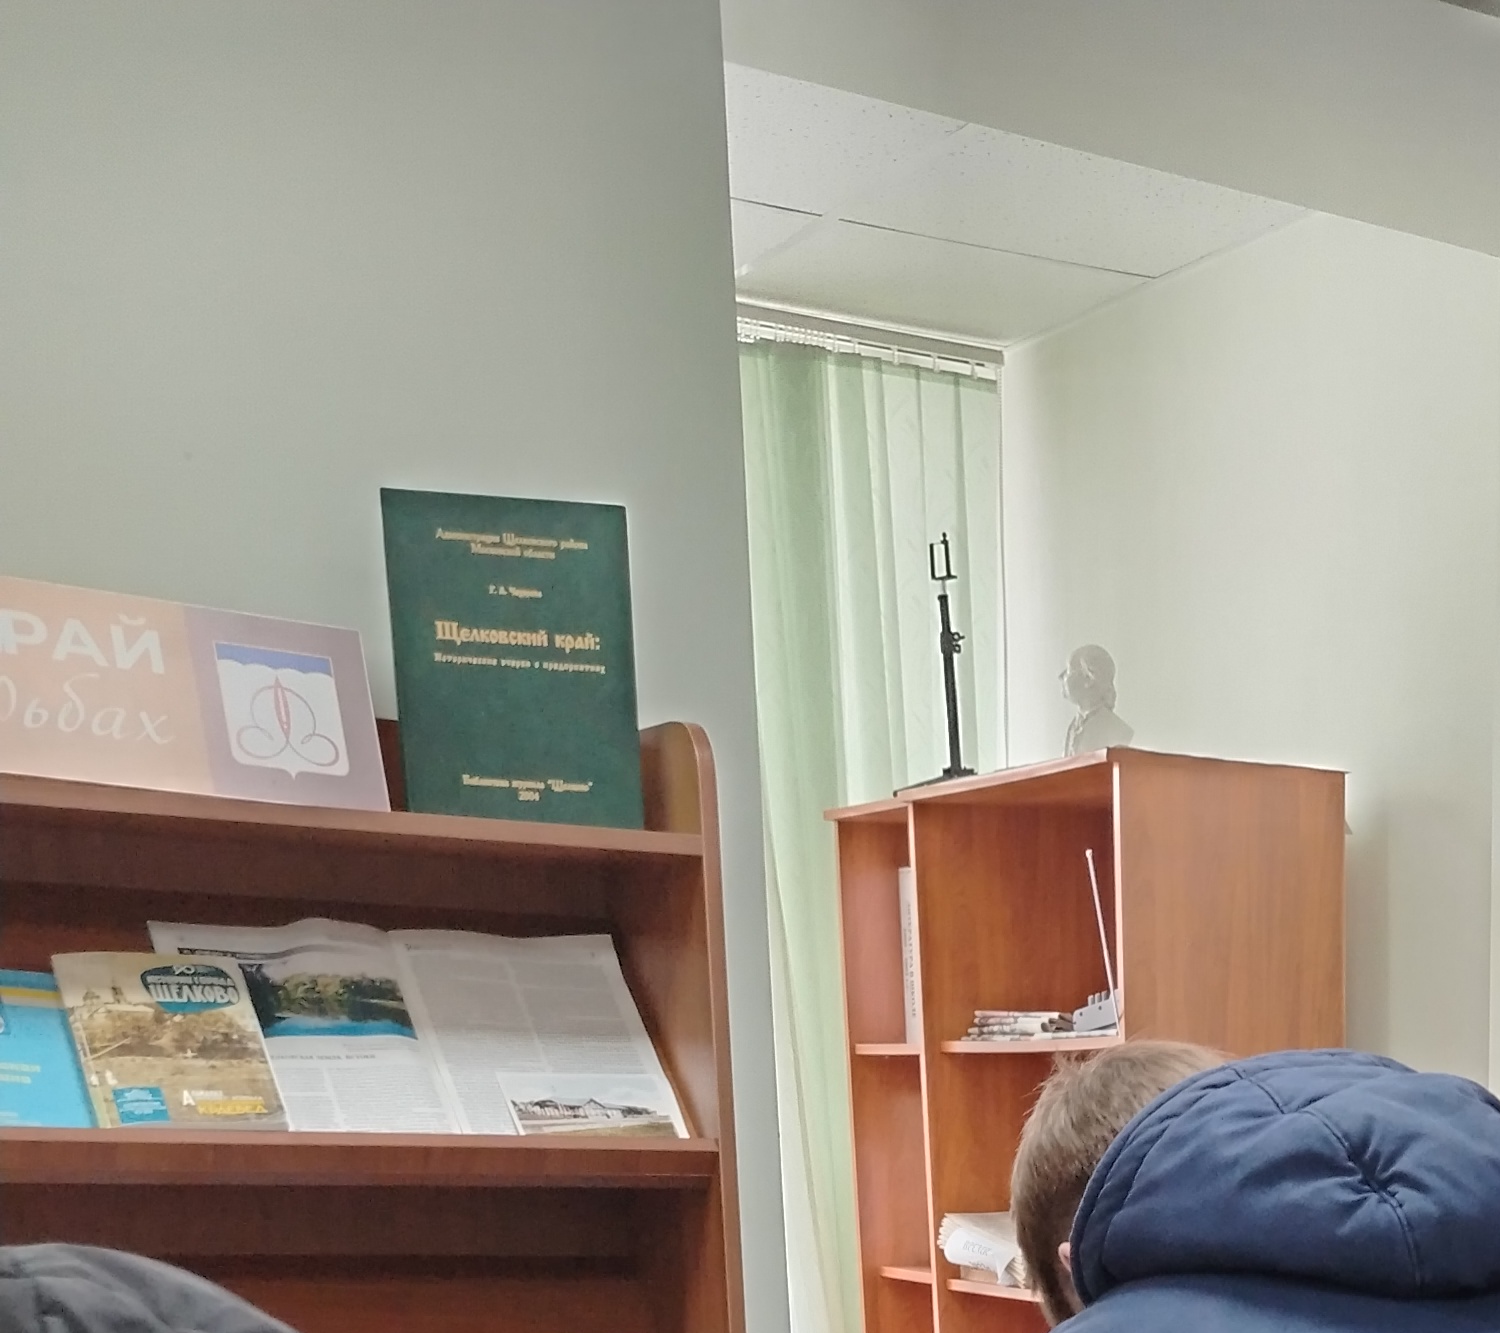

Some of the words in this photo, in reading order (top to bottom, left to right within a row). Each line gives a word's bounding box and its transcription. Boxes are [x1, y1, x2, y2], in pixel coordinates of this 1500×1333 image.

[0, 608, 165, 674] РАЙ
[434, 620, 549, 647] Щелковский
[554, 631, 601, 654] край:
